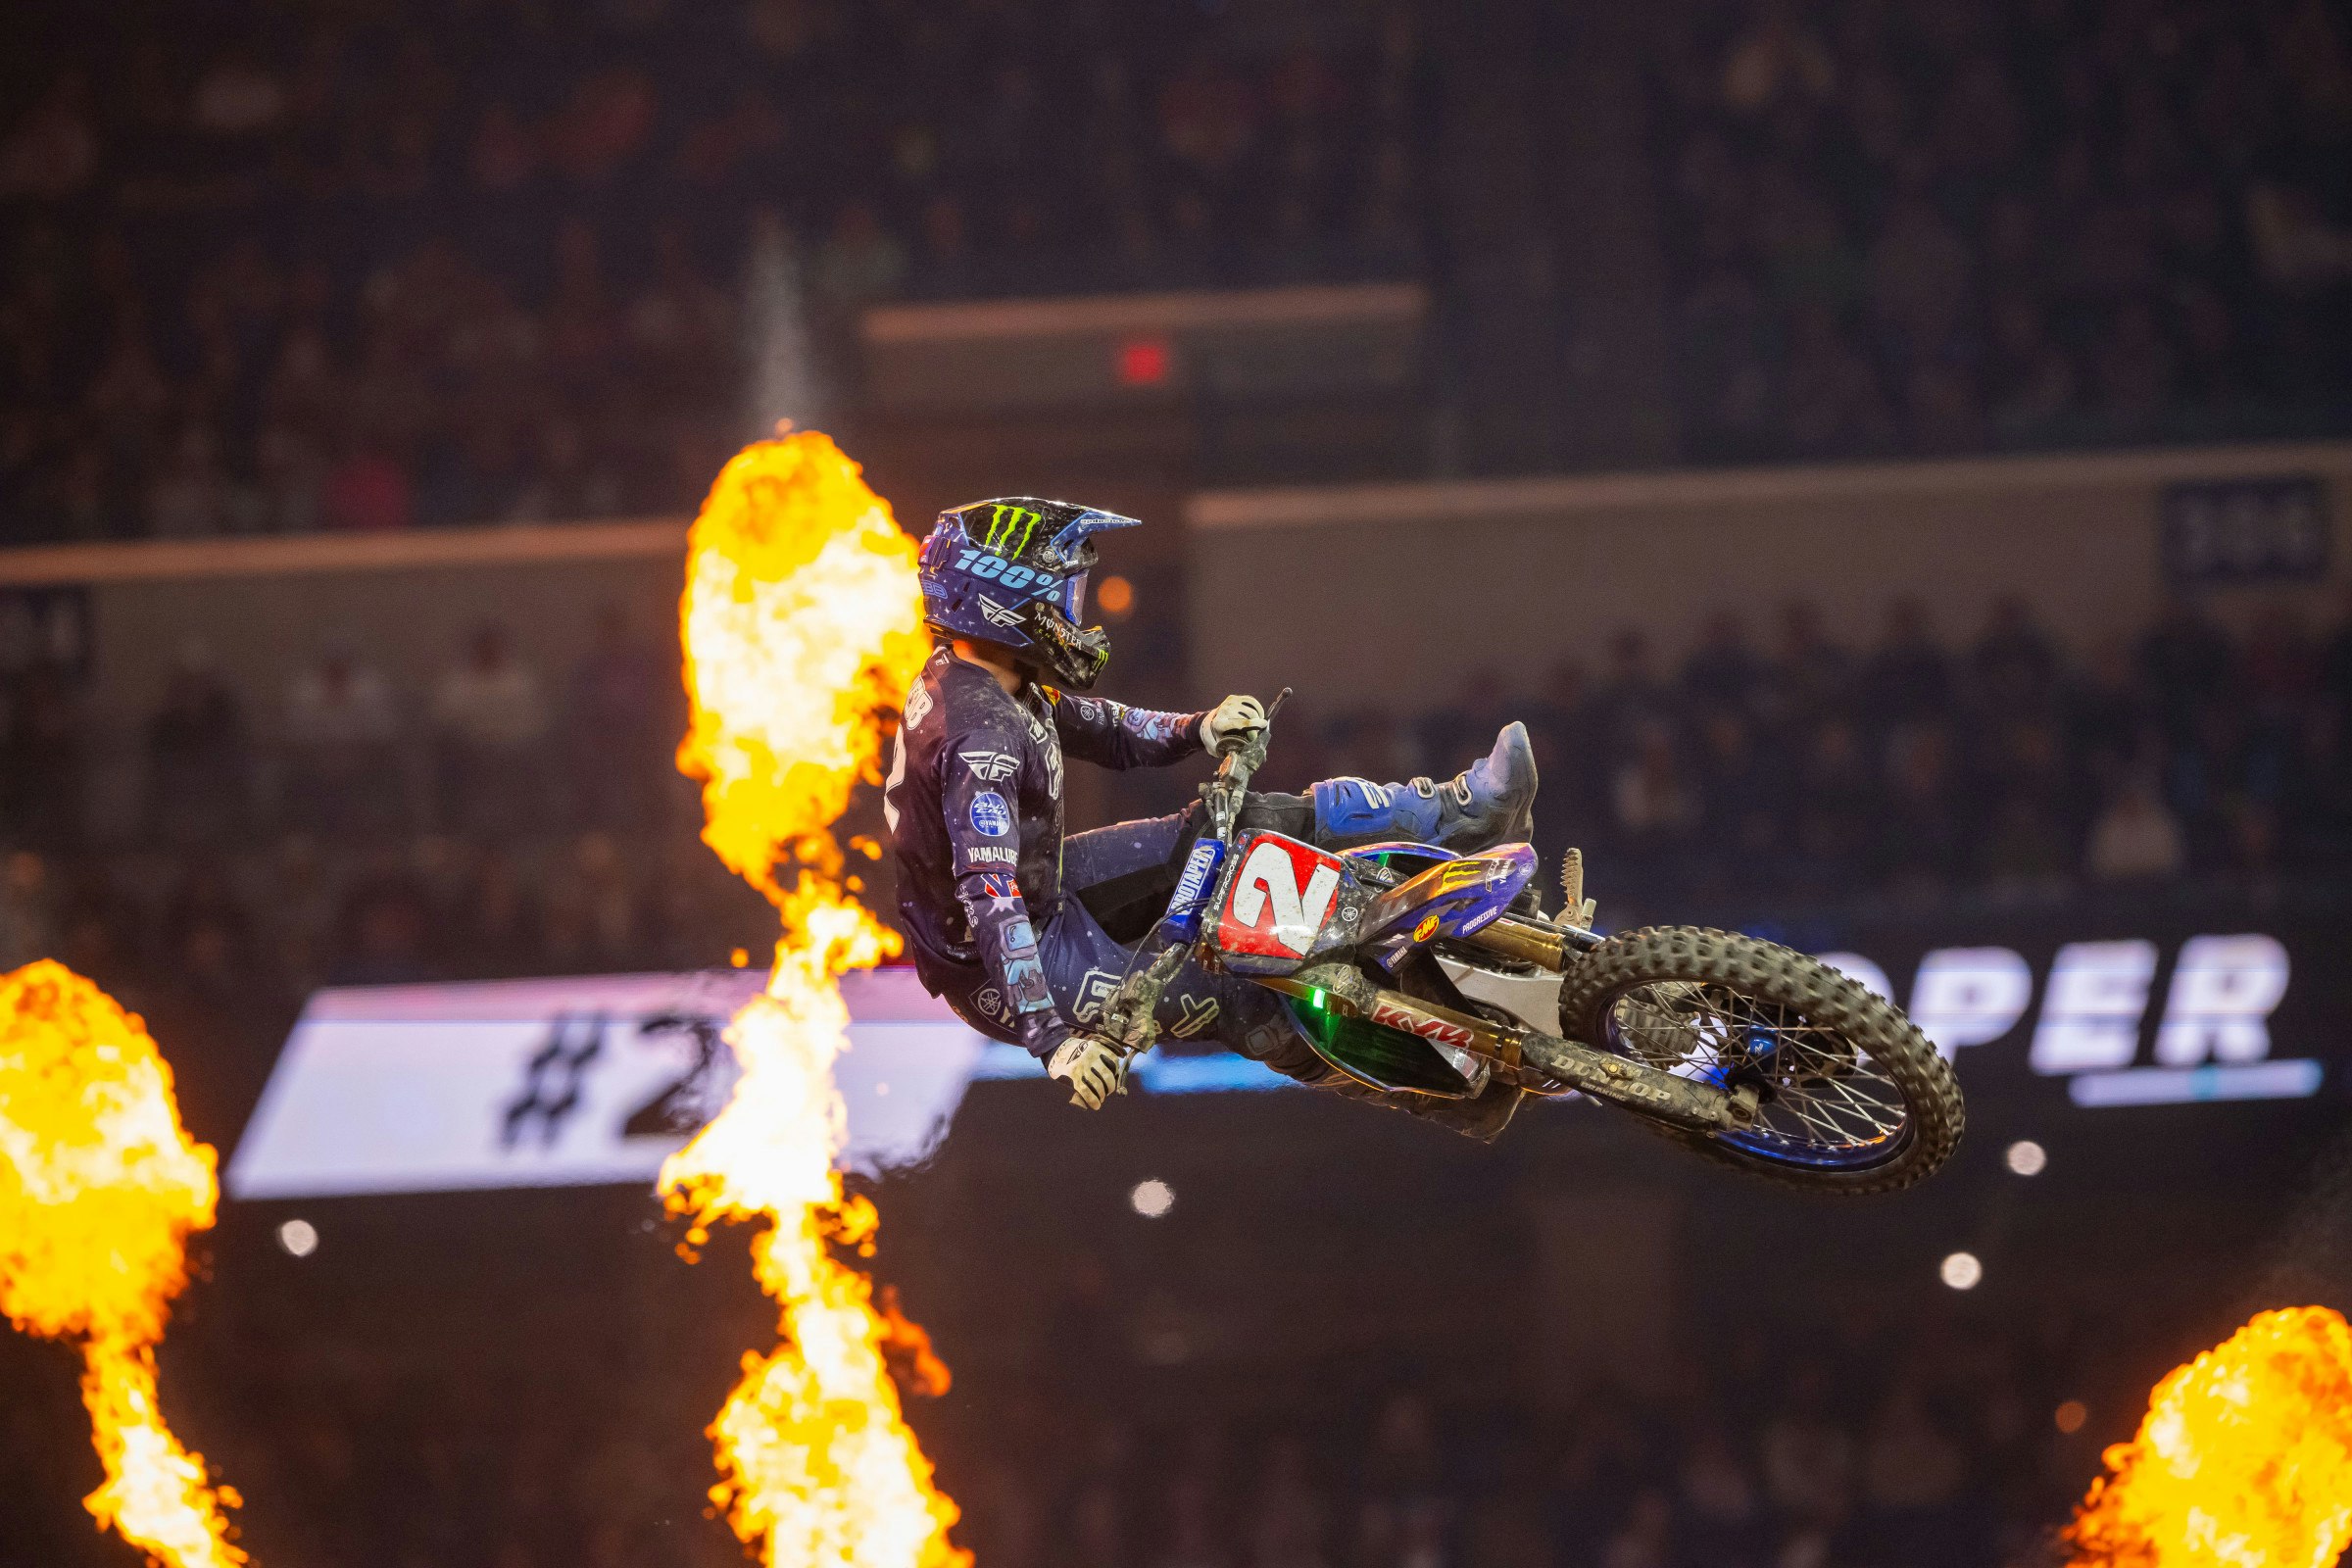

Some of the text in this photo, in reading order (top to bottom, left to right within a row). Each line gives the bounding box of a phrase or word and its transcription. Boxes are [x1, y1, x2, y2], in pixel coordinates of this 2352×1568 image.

[955, 549, 1060, 602] 100%
[1035, 611, 1082, 650] MONSTER
[1233, 842, 1341, 956] 2
[1462, 906, 1497, 935] PROGRESSIVE
[1413, 913, 1440, 943] FMF
[1550, 1054, 1671, 1102] DUNLOP
